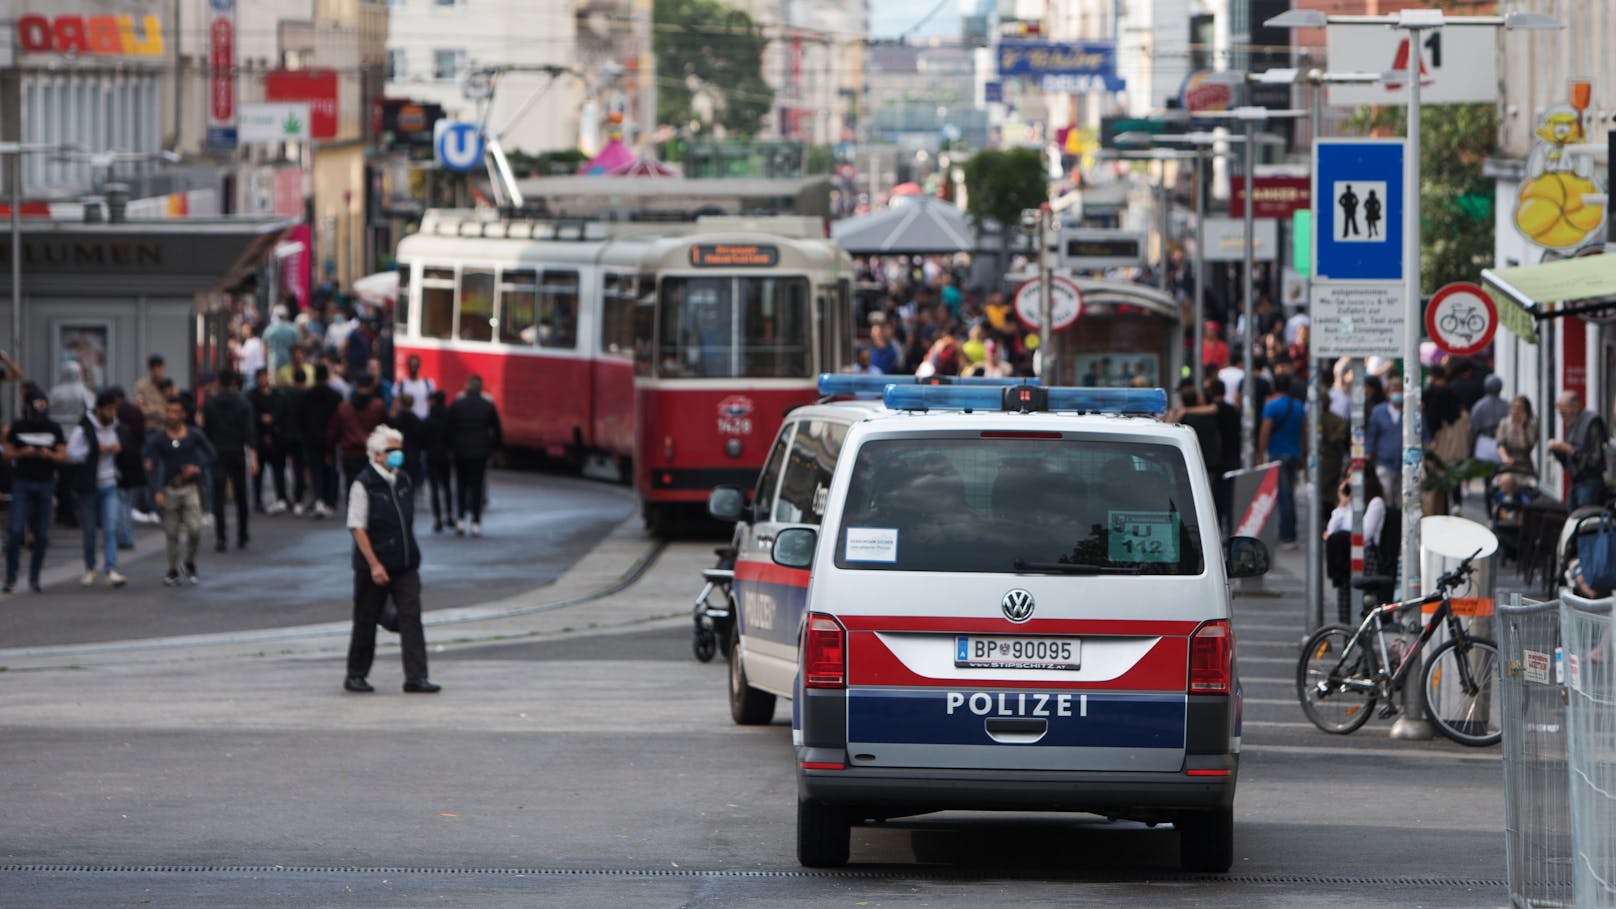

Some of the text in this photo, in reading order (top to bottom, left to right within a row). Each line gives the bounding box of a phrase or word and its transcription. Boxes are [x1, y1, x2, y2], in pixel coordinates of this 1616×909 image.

[445, 130, 477, 167] U
[1121, 540, 1162, 555] 112
[975, 640, 1072, 660] BP 90095
[946, 692, 1088, 717] POLIZEI
